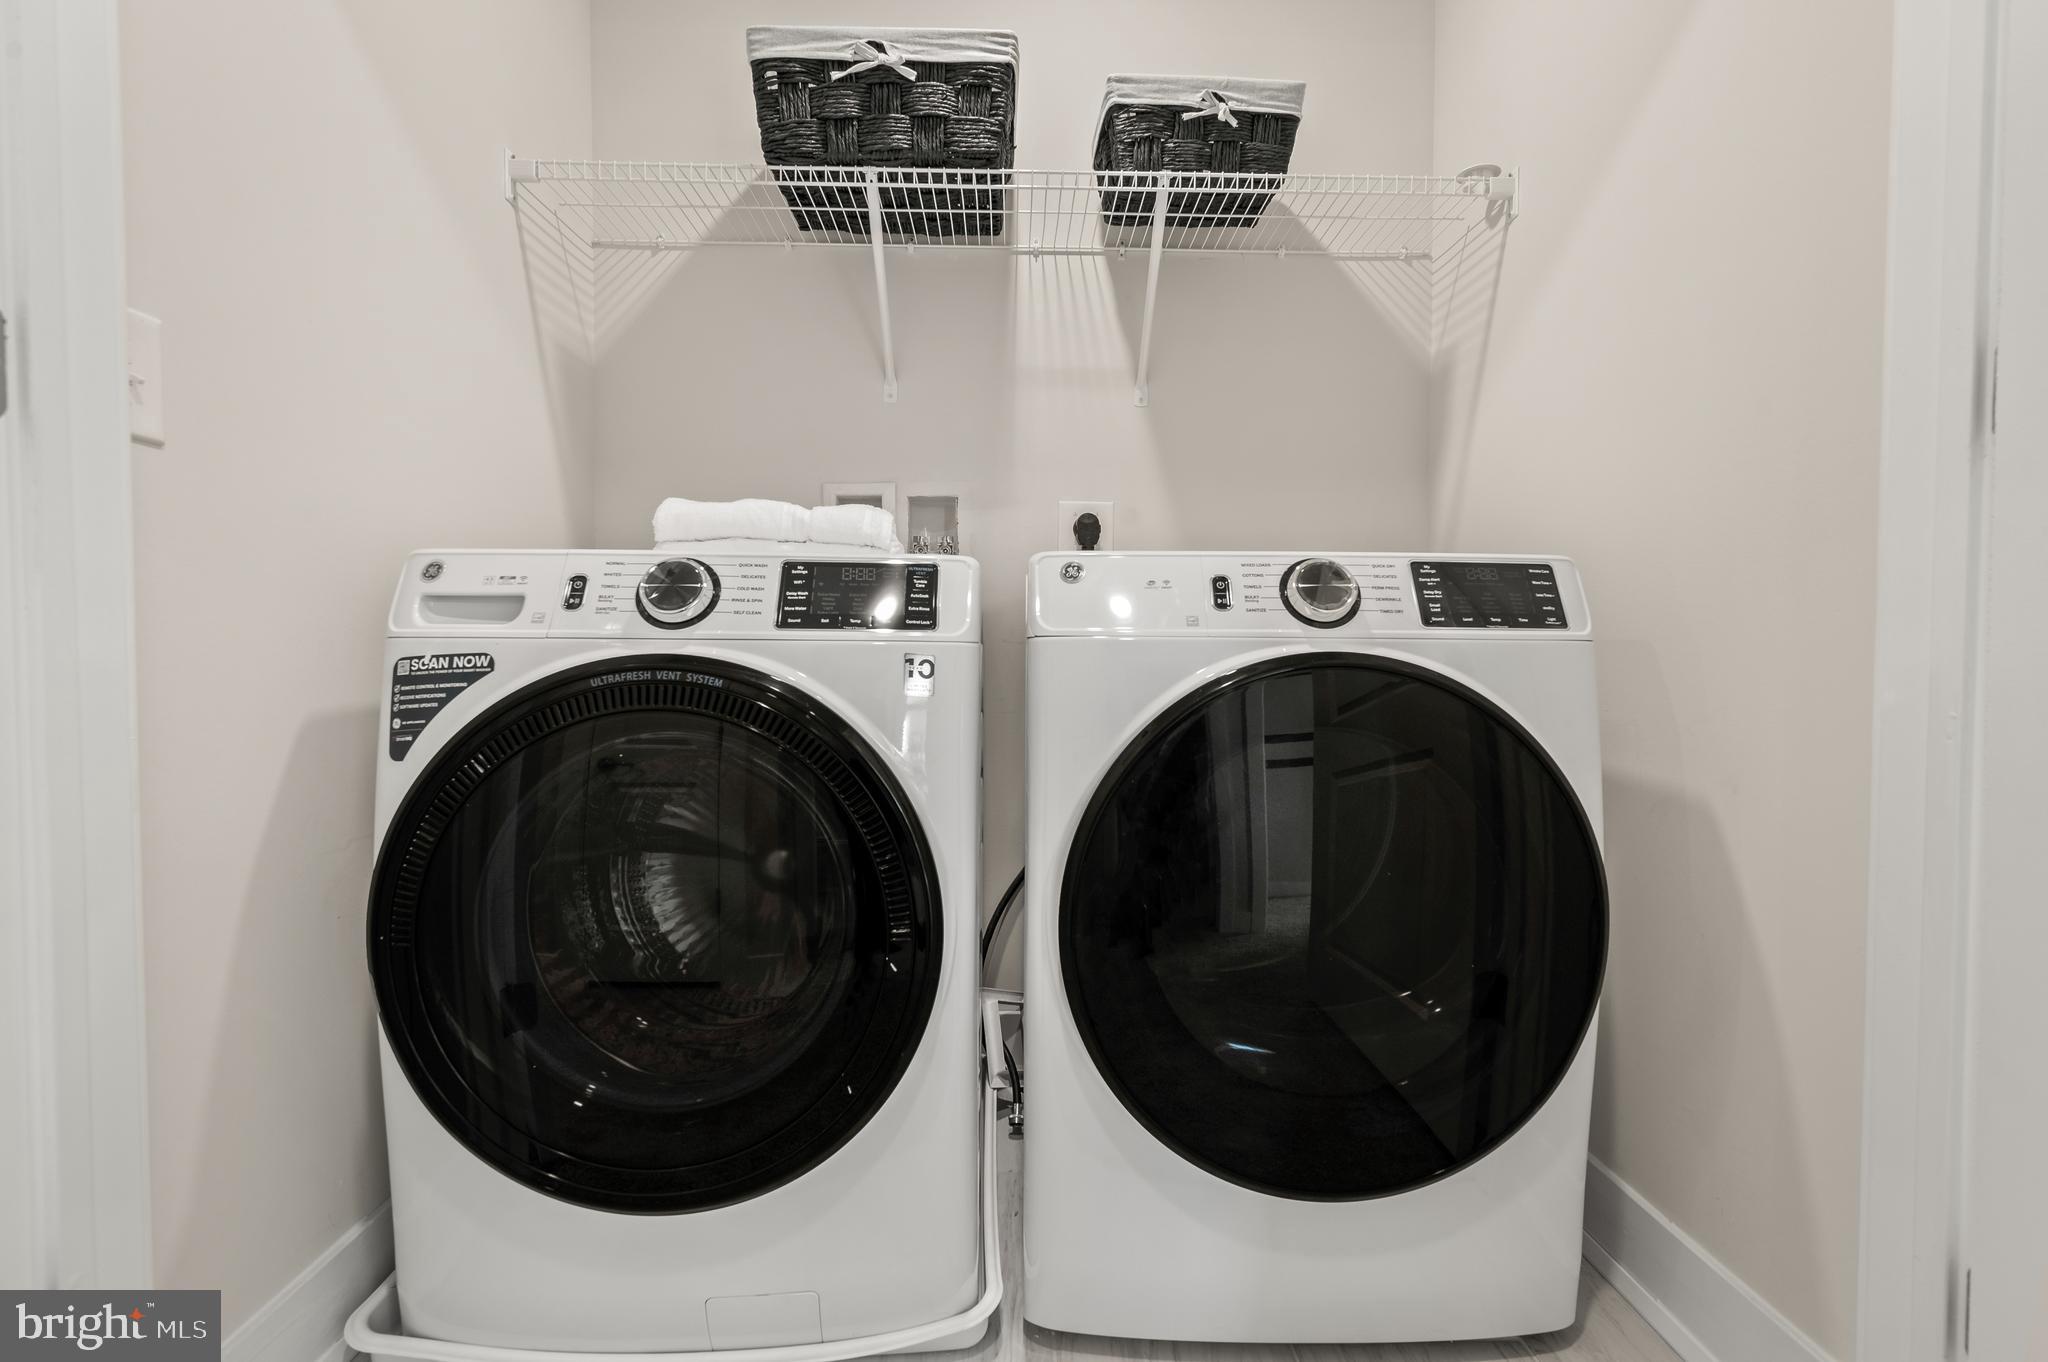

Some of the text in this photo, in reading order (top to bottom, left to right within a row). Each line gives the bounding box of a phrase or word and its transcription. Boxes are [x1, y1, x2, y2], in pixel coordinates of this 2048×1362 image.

[410, 655, 491, 671] SCAN NOW
[590, 670, 723, 687] ULTRAFRESH VENT SYSTEM
